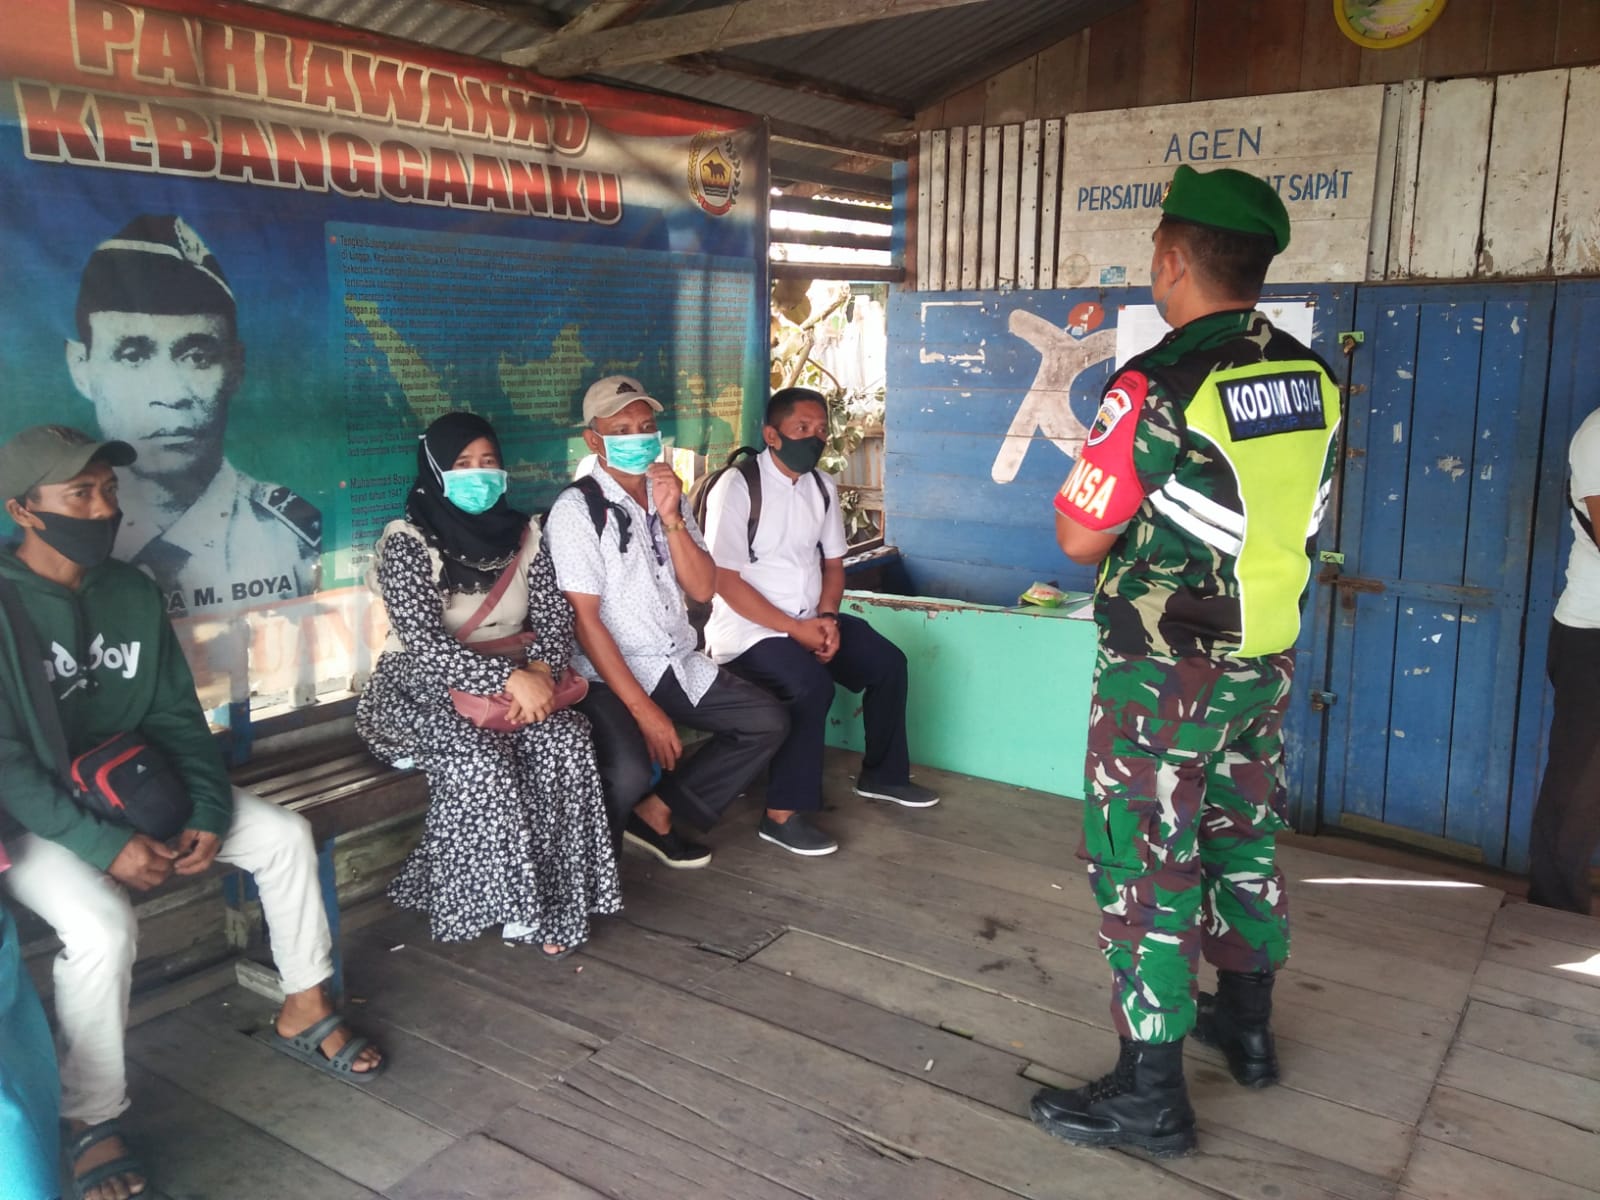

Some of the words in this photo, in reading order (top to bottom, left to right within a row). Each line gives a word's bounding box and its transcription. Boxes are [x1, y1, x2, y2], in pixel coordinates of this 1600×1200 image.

[69, 0, 590, 155] PAHLAWANKU
[13, 77, 622, 225] KEBANGGAANKU
[1164, 126, 1263, 163] AGEN
[1077, 180, 1173, 211] PERSATUA
[1288, 171, 1353, 201] SAPAT
[1227, 380, 1292, 422] KODIM
[1290, 378, 1321, 413] 0314
[1061, 456, 1118, 519] NSA
[193, 586, 223, 607] M.
[231, 574, 293, 601] BOYA
